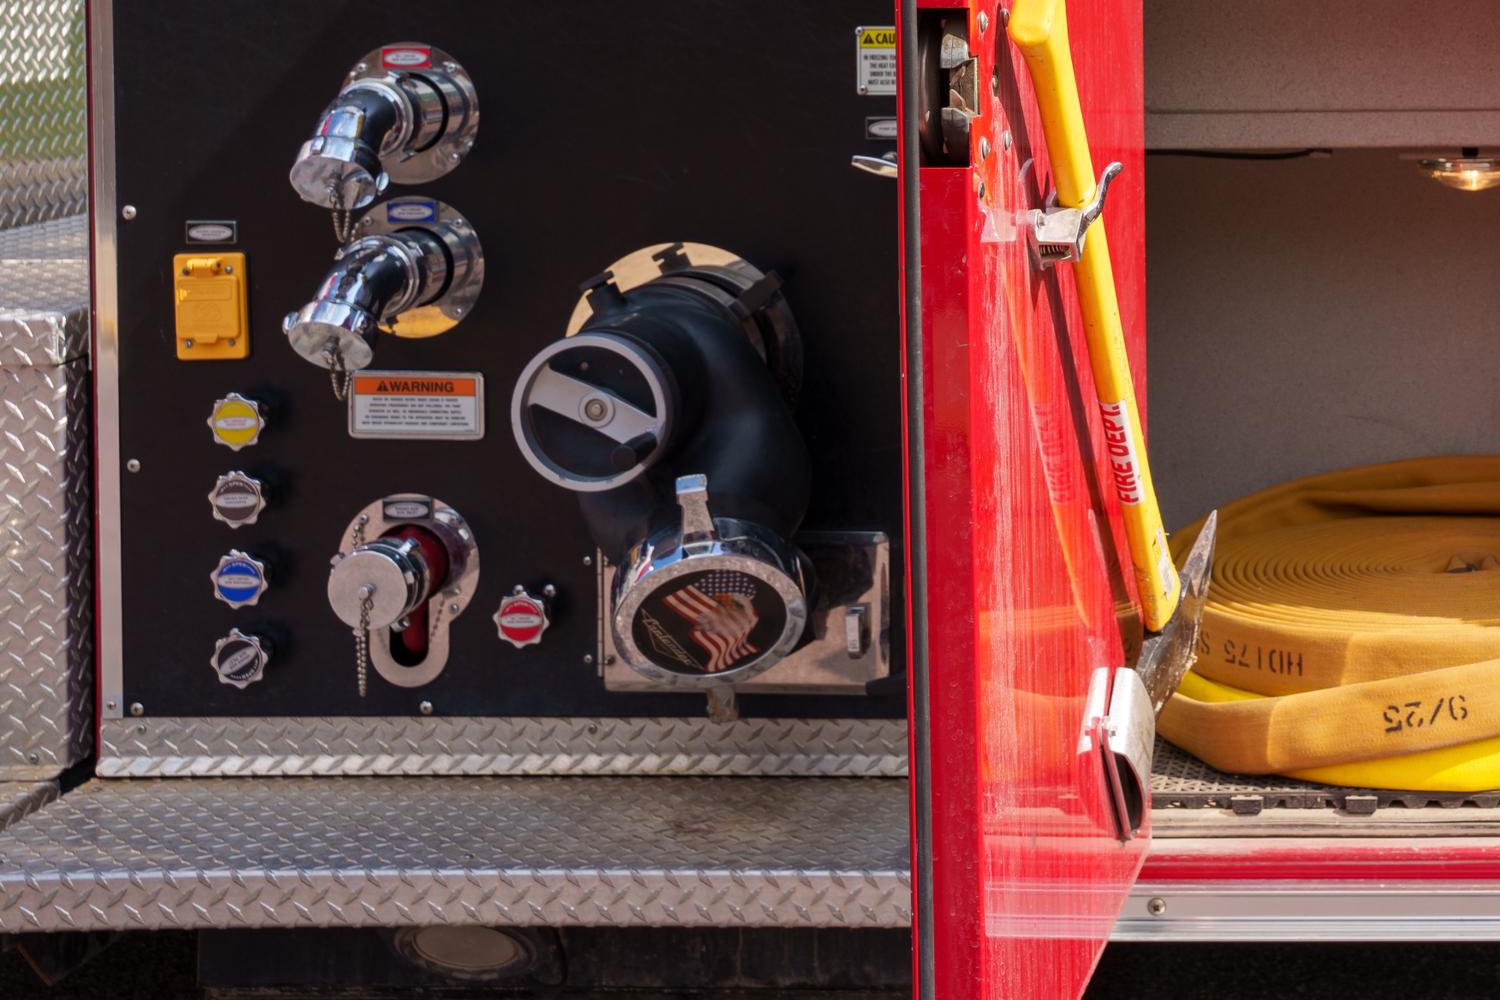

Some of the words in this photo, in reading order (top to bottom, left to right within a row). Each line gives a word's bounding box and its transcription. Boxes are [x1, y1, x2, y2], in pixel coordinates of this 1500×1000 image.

[875, 32, 896, 45] CAU
[389, 380, 454, 392] WARNING
[1111, 460, 1139, 503] FIRE
[1383, 694, 1468, 734] 9/25
